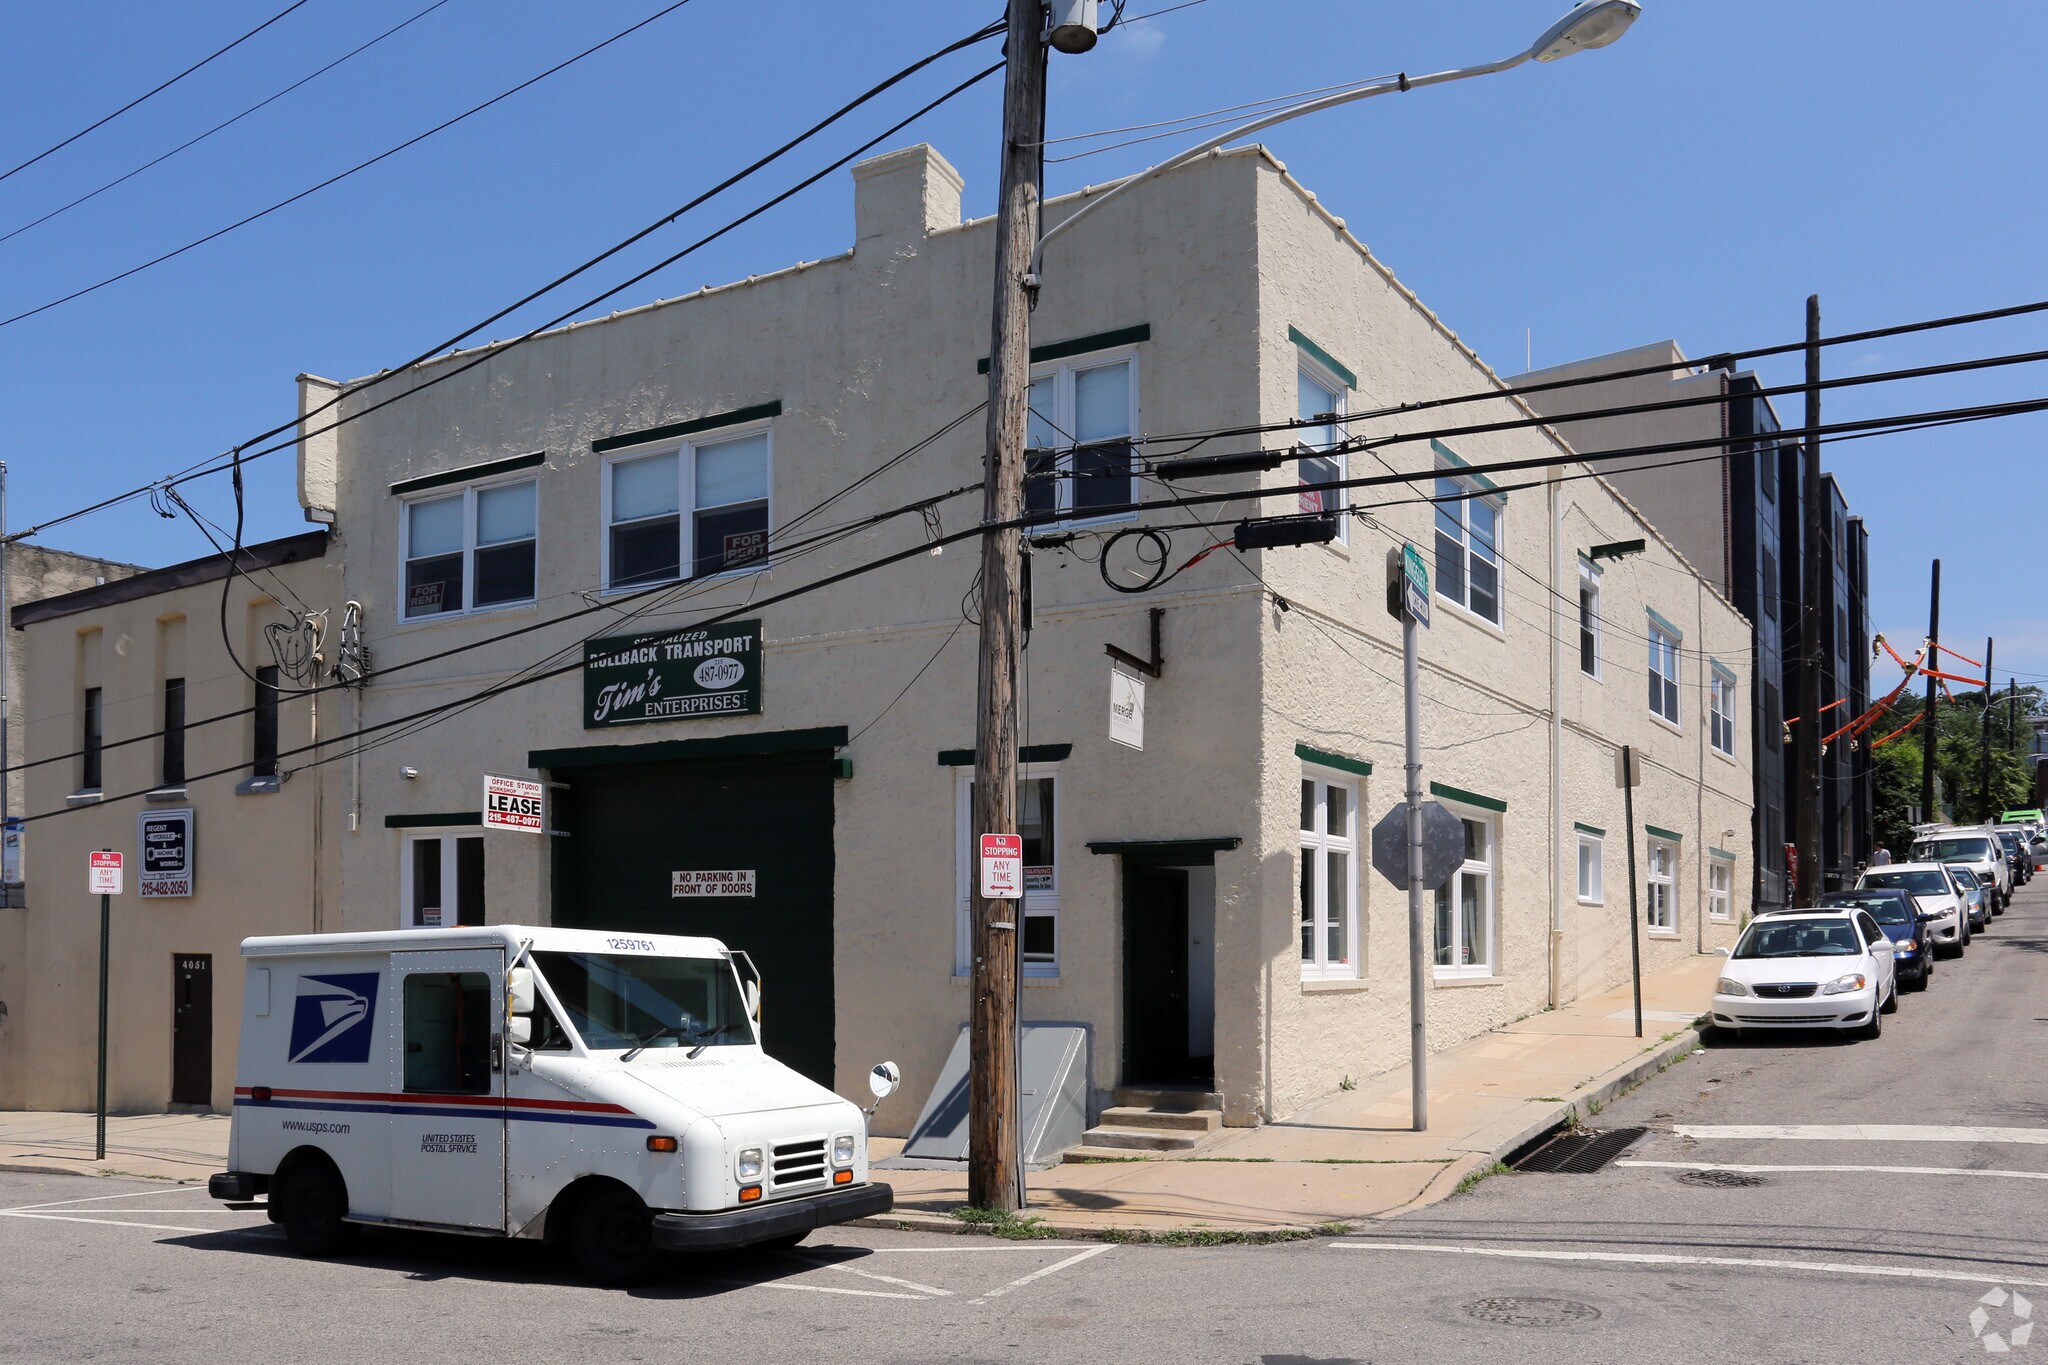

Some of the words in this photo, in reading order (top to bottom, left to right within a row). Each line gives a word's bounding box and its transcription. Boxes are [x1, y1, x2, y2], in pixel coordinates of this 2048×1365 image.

[732, 534, 761, 548] FOR
[728, 543, 767, 560] RENT
[415, 585, 438, 597] FOR
[410, 593, 440, 606] RENT
[590, 646, 658, 669] ROLLBACK
[665, 636, 753, 660] TRANSPORT
[699, 663, 739, 682] 487-0977
[593, 668, 662, 721] Tim's
[645, 694, 741, 716] ENTERPRISES
[1113, 702, 1133, 720] MERGE
[489, 785, 517, 794] WORKSHOP
[491, 778, 514, 788] OFFICE
[516, 782, 540, 792] STUDIO
[489, 794, 541, 816] LEASE
[489, 812, 541, 827] 215-487-0977
[146, 824, 168, 832] REGENT
[996, 837, 1007, 846] NO
[985, 846, 1018, 856] STOPPING
[993, 860, 1011, 870] ANY
[99, 876, 114, 884] TIME
[680, 872, 692, 882] NO
[695, 872, 733, 882] PARKING
[737, 871, 747, 882] IN
[992, 871, 1012, 882] TIME
[141, 881, 188, 895] 215-482-2050
[673, 884, 702, 894] FRONT
[705, 884, 718, 893] OF
[721, 883, 752, 893] DOORS
[606, 938, 656, 951] 1259761
[182, 960, 205, 969] 4051
[282, 1120, 351, 1134] www.usps.com
[422, 1134, 449, 1143] UNITED
[450, 1134, 475, 1143] STATES
[420, 1144, 447, 1153] POSTAL
[448, 1144, 478, 1153] SERVICE
